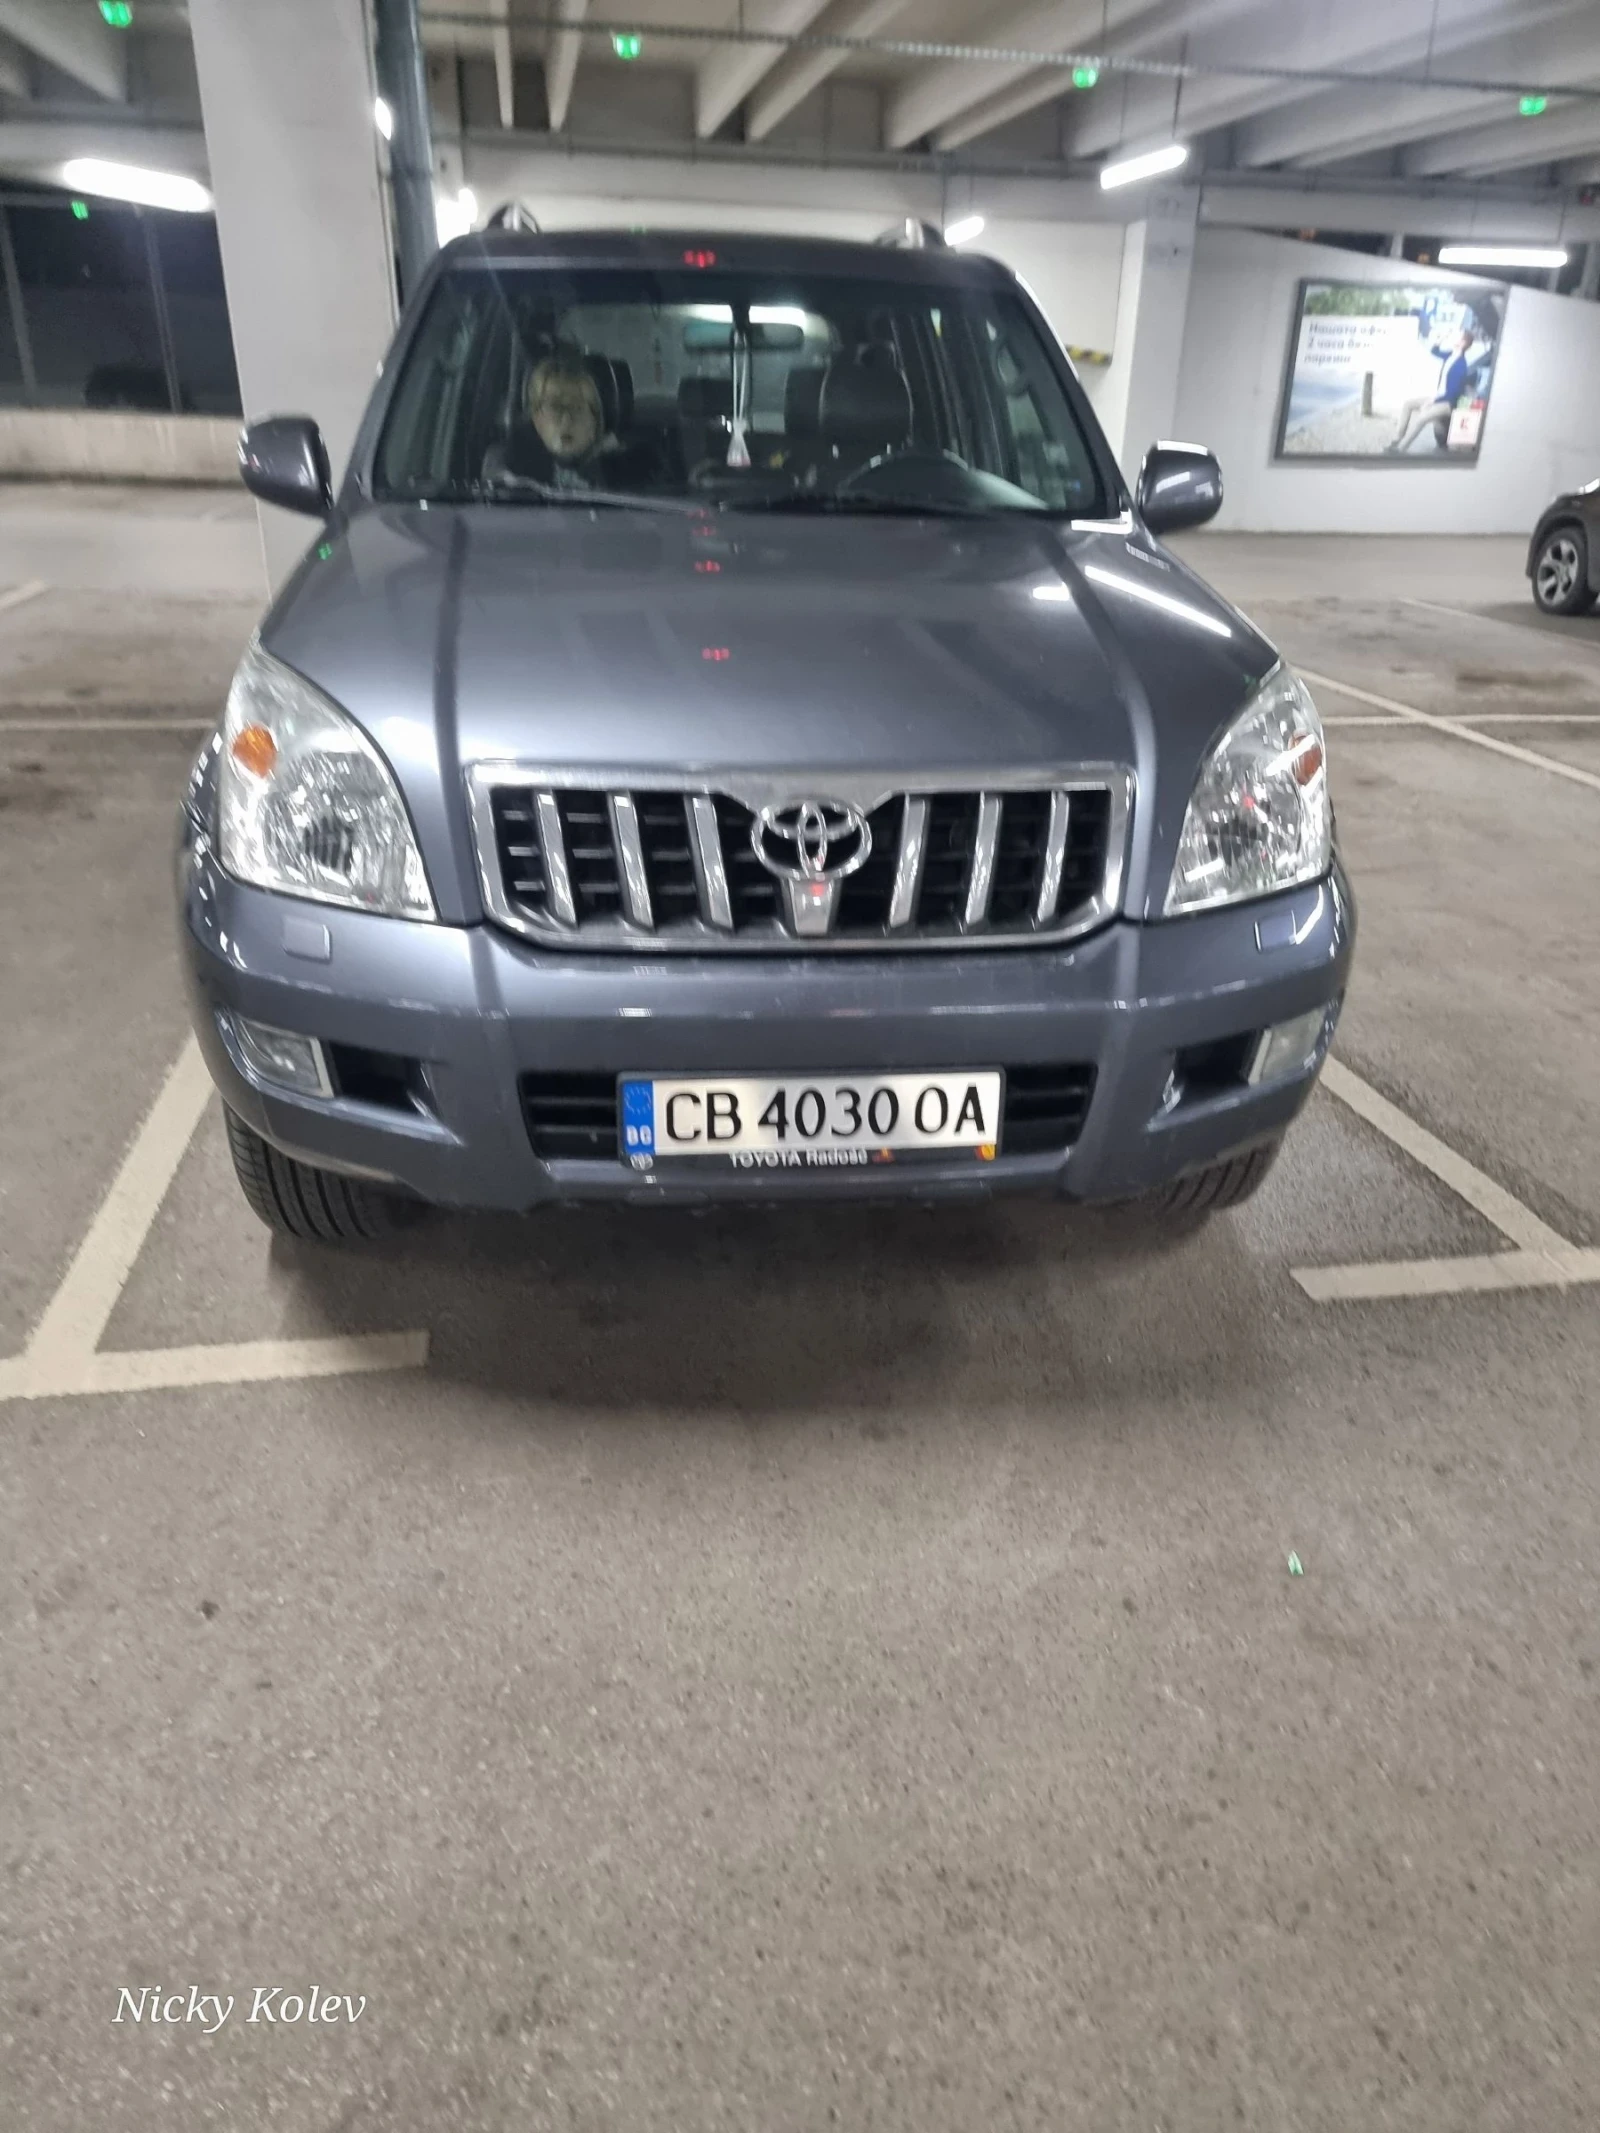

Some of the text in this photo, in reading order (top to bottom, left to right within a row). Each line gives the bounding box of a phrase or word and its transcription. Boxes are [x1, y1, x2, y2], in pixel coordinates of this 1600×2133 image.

[665, 1082, 986, 1141] CB 4030 OA
[729, 1150, 802, 1168] TOYOTA
